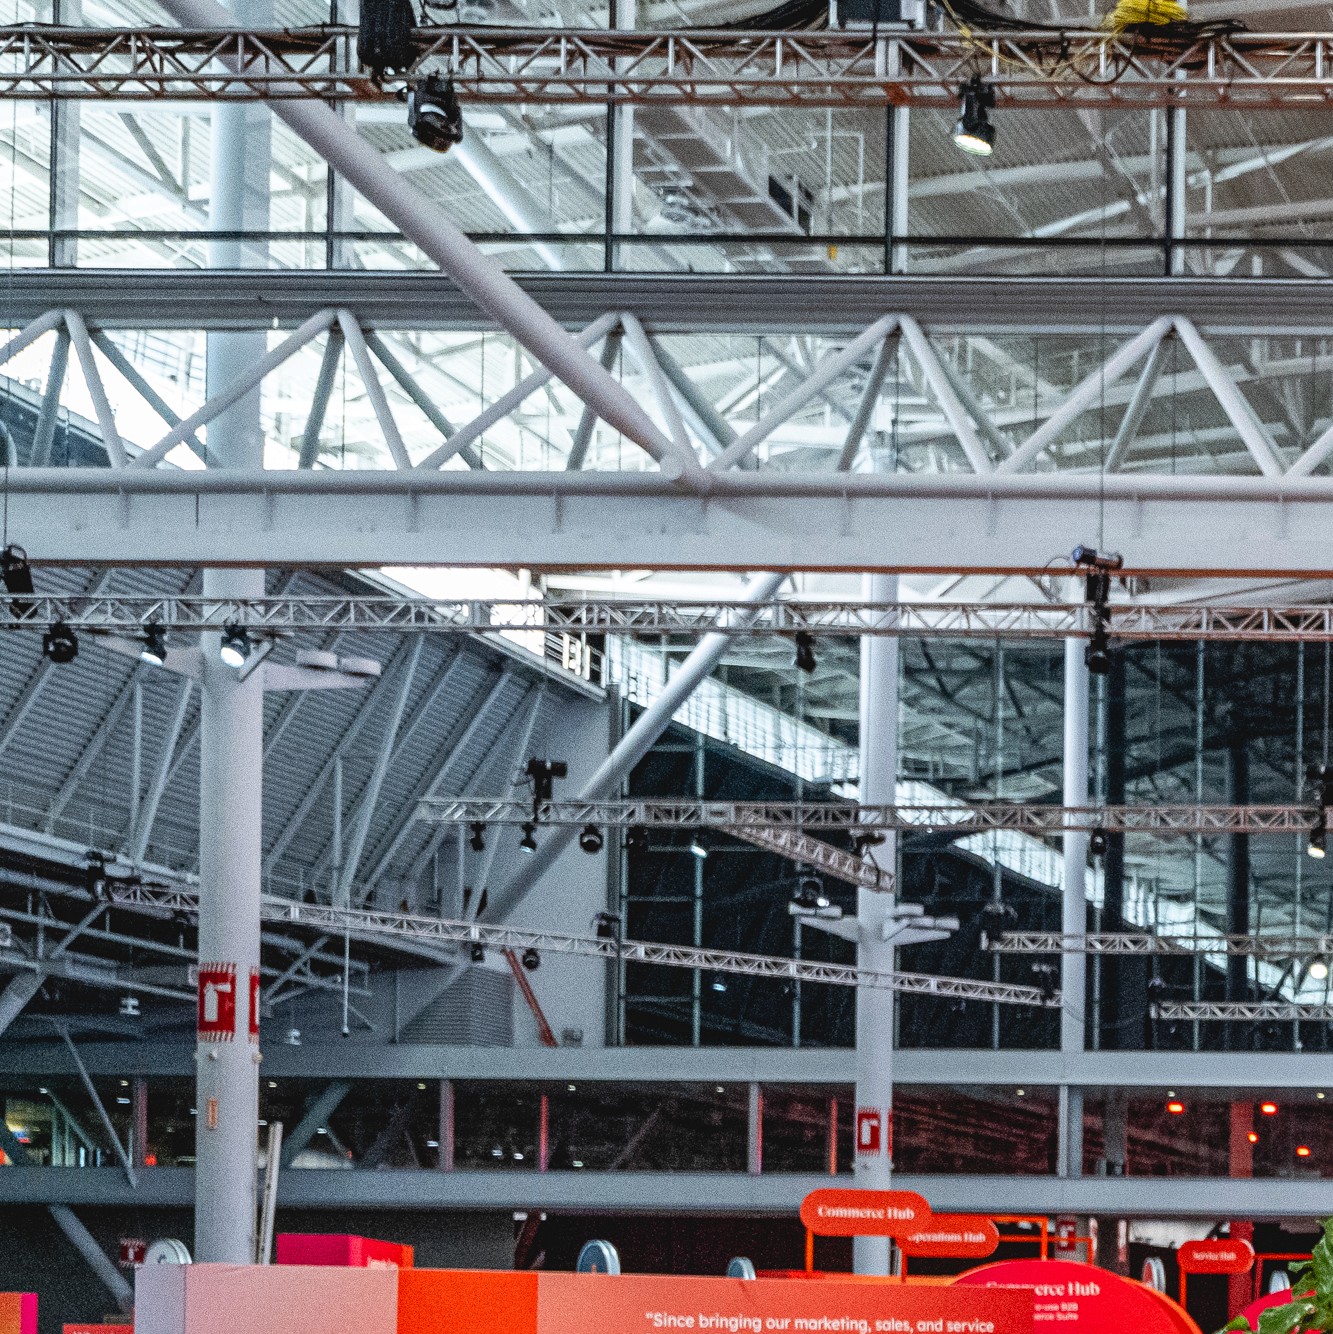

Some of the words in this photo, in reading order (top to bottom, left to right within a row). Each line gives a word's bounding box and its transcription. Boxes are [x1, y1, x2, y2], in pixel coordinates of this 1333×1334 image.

[817, 1205, 886, 1219] Commerce
[887, 1206, 915, 1220] Hub
[963, 1232, 987, 1243] Hub
[1068, 1281, 1101, 1297] Hub
[698, 1313, 762, 1333] bringing
[765, 1317, 791, 1330] our
[794, 1316, 871, 1334] marketing,
[875, 1319, 914, 1333] sales,
[917, 1319, 943, 1332] and
[946, 1319, 995, 1333] service
